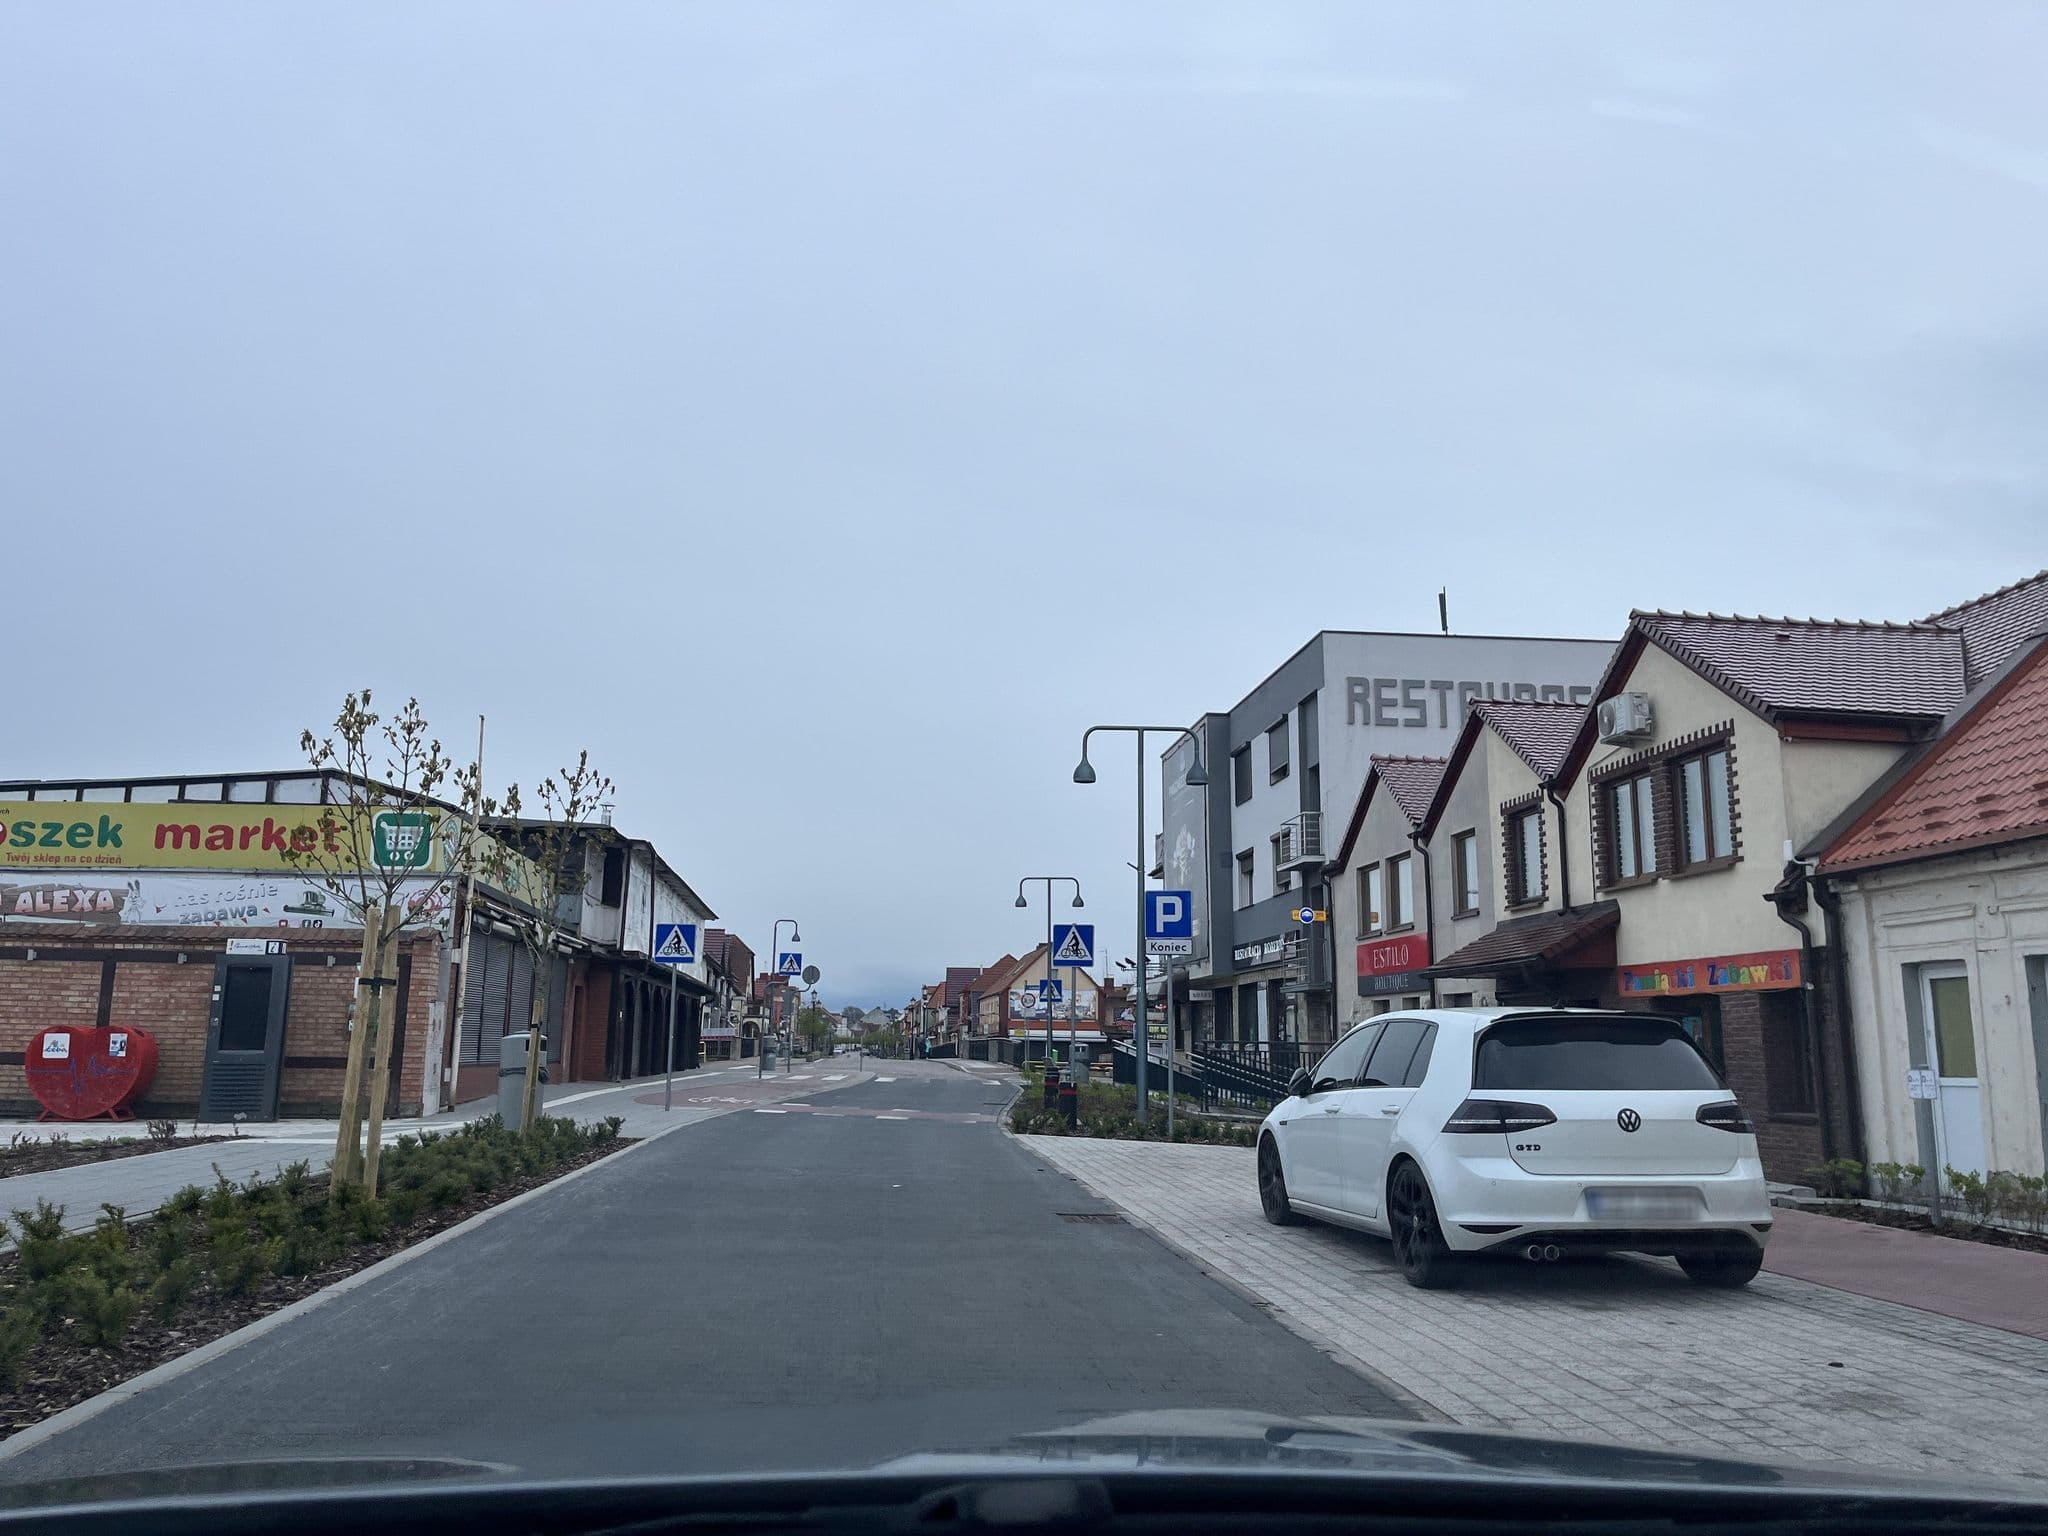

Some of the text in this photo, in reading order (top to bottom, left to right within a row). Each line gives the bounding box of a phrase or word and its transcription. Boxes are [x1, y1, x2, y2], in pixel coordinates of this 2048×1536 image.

[154, 817, 341, 853] market
[6, 852, 122, 865] Twój sklep na co dzień
[14, 889, 115, 913] ALEXA
[179, 903, 259, 925] zabawa
[1156, 896, 1183, 933] P
[1150, 942, 1187, 953] Koniec
[1373, 944, 1409, 969] ESTILO
[1374, 973, 1409, 991] BOUTIQUE
[1707, 954, 1793, 986] Zabawki
